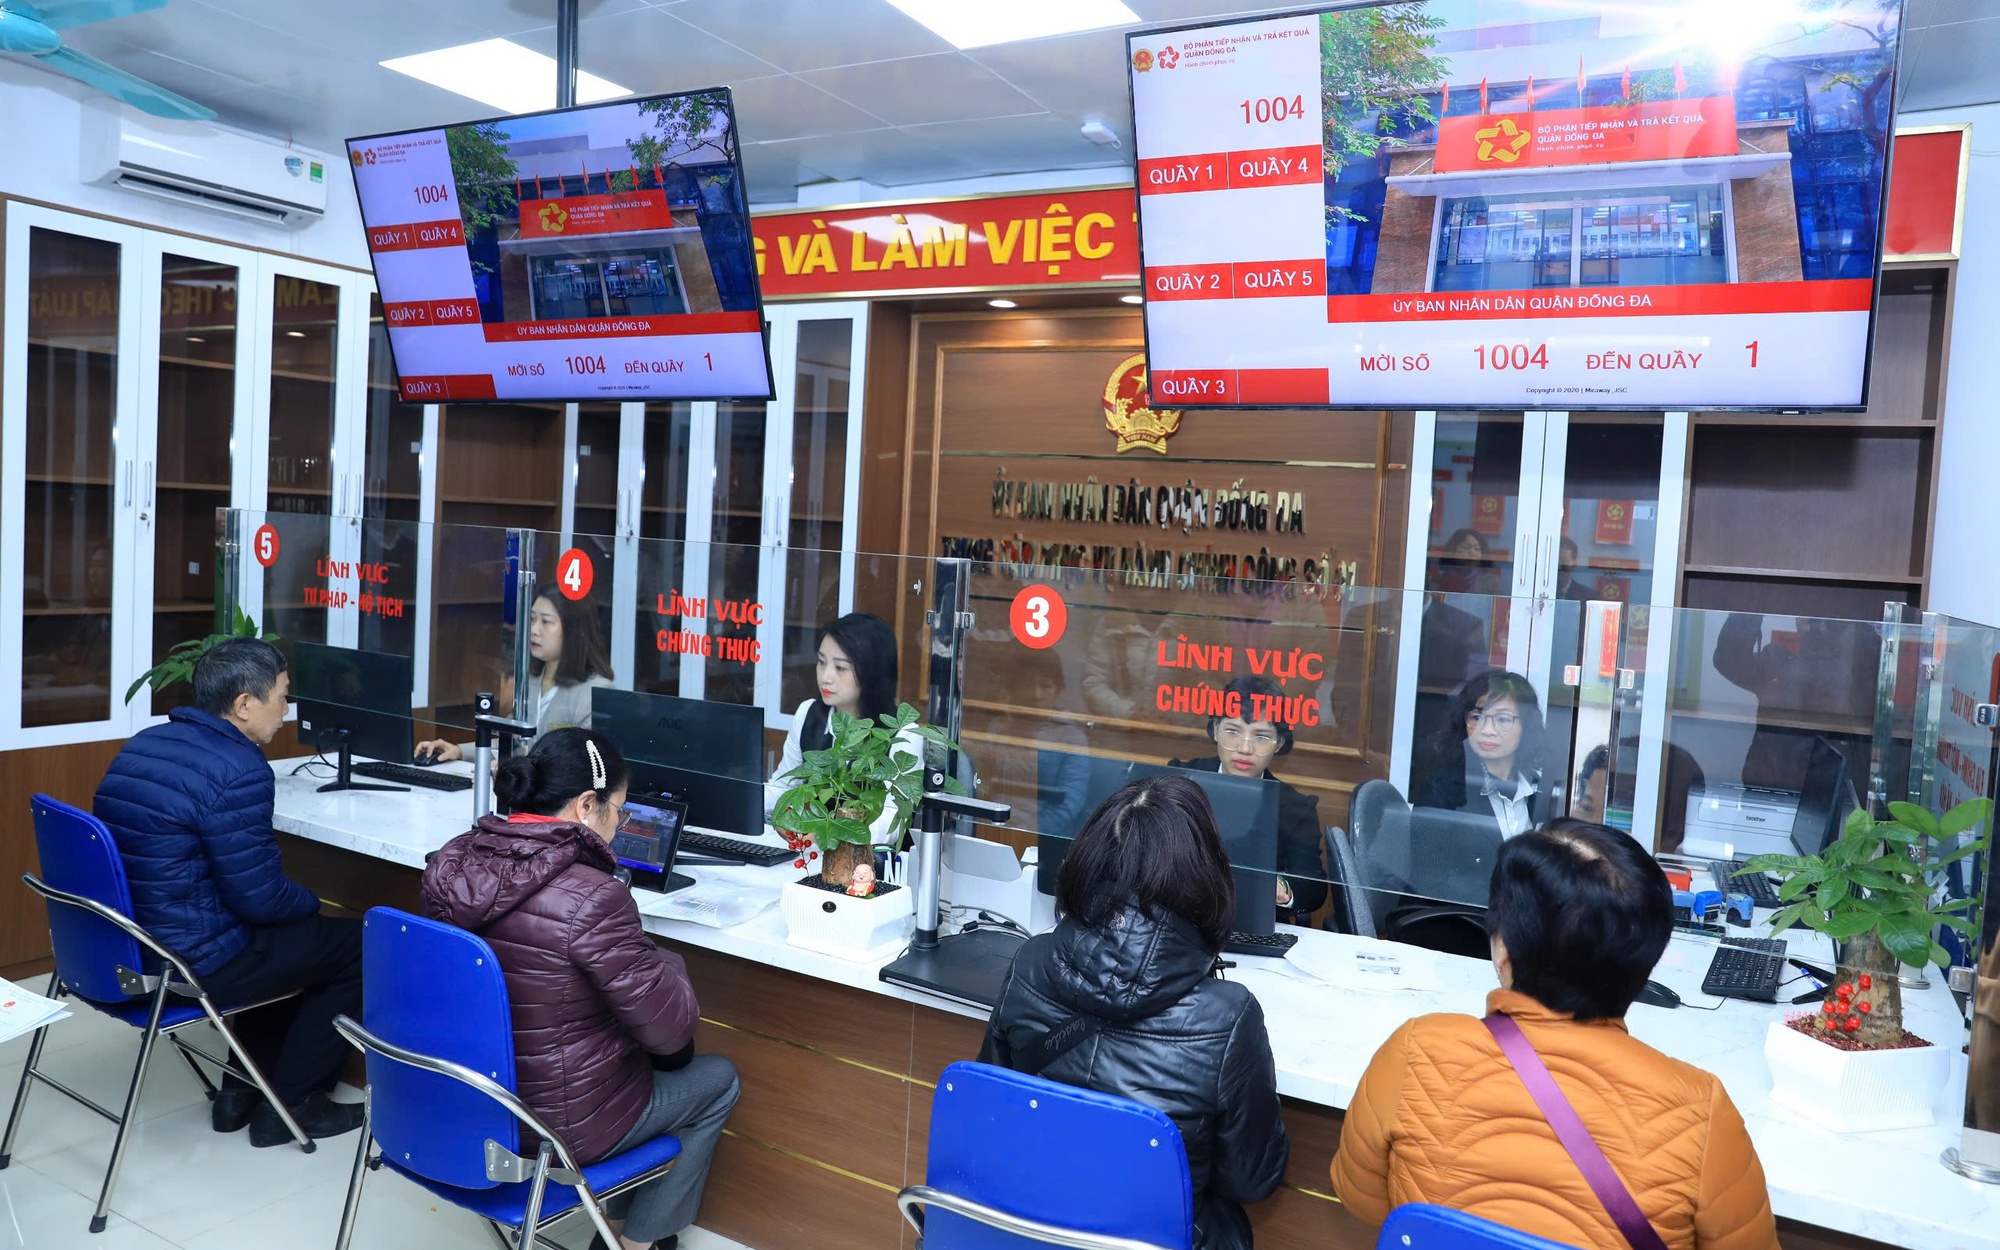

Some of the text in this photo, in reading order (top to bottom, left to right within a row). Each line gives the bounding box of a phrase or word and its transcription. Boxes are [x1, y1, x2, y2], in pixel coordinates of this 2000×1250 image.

[1184, 46, 1237, 58] QUẬN ĐỐNG ĐA
[1240, 95, 1304, 124] 1004
[1150, 164, 1213, 184] QUẦY 1
[1240, 157, 1308, 178] QUẦY 4
[414, 184, 448, 204] 1004
[374, 232, 408, 245] QUẦY 1
[421, 227, 457, 241] QUẦY 4
[778, 219, 838, 275] VÀ
[851, 213, 969, 272] LÀM
[983, 202, 1115, 276] VIỆC
[1156, 273, 1220, 292] QUẦY 2
[1245, 269, 1313, 288] QUẦY 5
[437, 305, 473, 318] QUẦY 5
[1394, 293, 1652, 313] ỦY BAN NHÂN DÂN QUẬN ĐỐNG ĐA
[390, 307, 425, 321] QUẦY 2
[517, 321, 651, 336] ỦY BAN NHÂN DÂN QUẬN ĐỐNG ĐA
[508, 352, 713, 376] MỜI SỐ 1004 ĐẾN QUẦY 1
[1360, 340, 1758, 371] MỜI SỐ 1004 ĐẾN QUẦY 1
[406, 381, 441, 394] QUẦY 3
[1162, 377, 1225, 395] QUẦY 3
[1060, 475, 1110, 522] NHÂN
[1113, 477, 1154, 524] DÂN
[1157, 478, 1210, 535] QUẬN
[261, 532, 272, 560] 5
[317, 554, 389, 587] LĨNH VỰC
[564, 559, 581, 592] 4
[304, 586, 318, 606] TƯ
[320, 587, 347, 609] PHÁP
[358, 591, 373, 616] HỘ
[376, 596, 403, 619] TỊCH
[657, 589, 764, 629] LĨNH VỰC
[1024, 595, 1050, 639] 3
[657, 627, 761, 666] CHỨNG THỰC
[1157, 634, 1323, 686] LĨNH VỰC
[1156, 681, 1319, 731] CHỨNG THỰC
[657, 716, 683, 730] AOC
